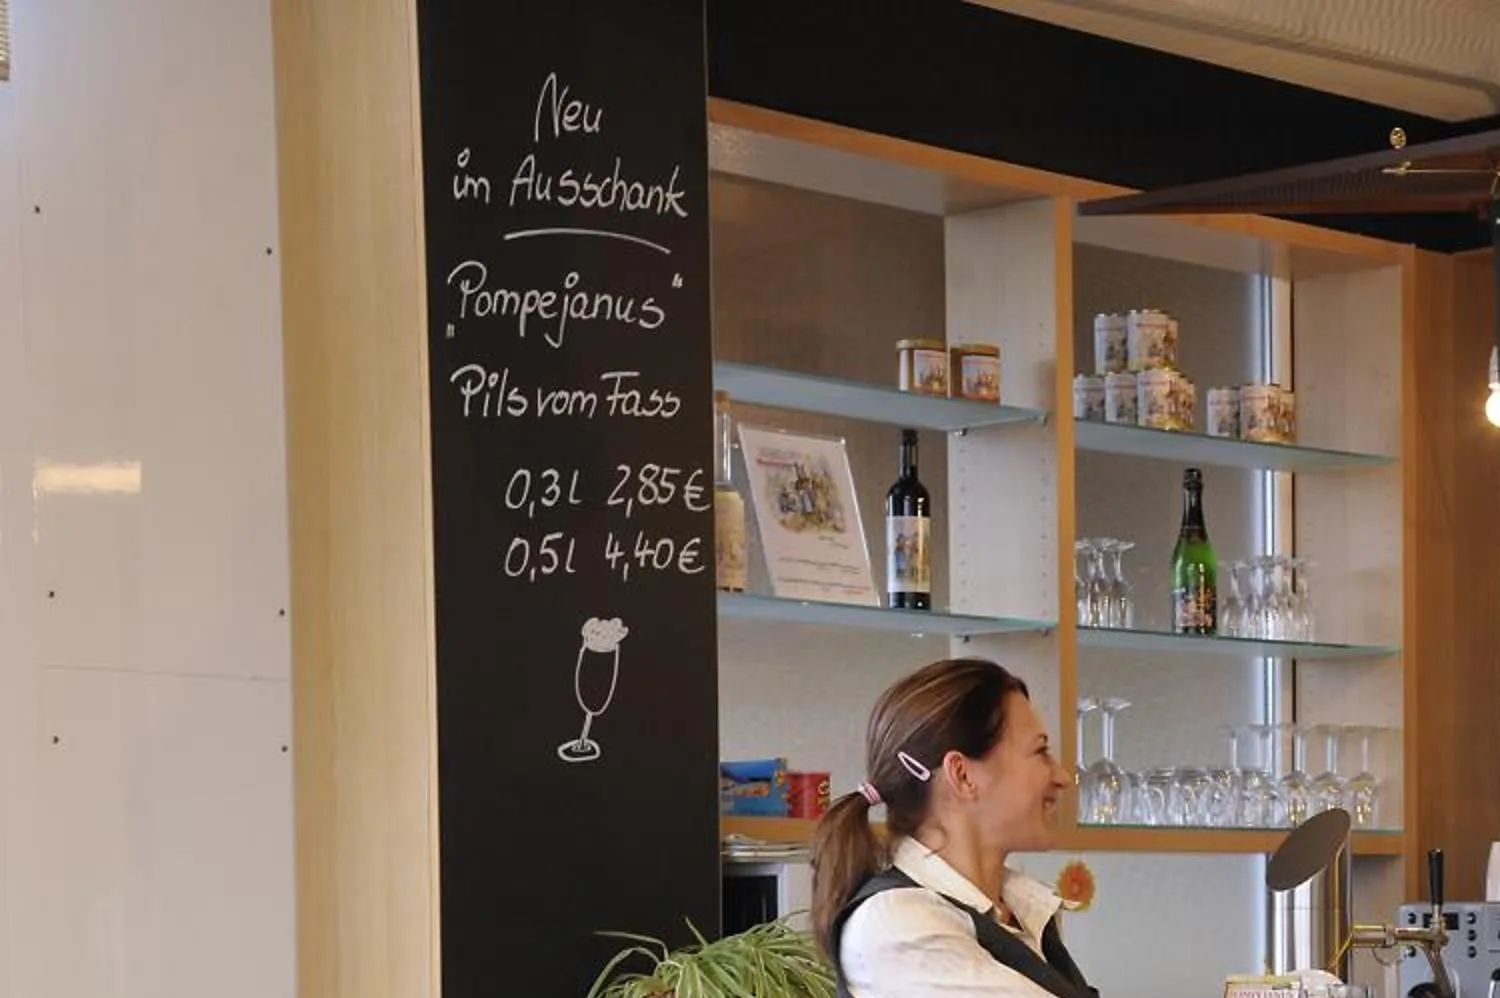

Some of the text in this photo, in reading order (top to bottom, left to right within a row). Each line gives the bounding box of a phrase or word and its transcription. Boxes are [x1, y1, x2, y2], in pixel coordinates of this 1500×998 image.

[535, 72, 602, 142] Neu
[453, 148, 688, 218] im Ausschank
[450, 364, 681, 418] Pils vom Fass
